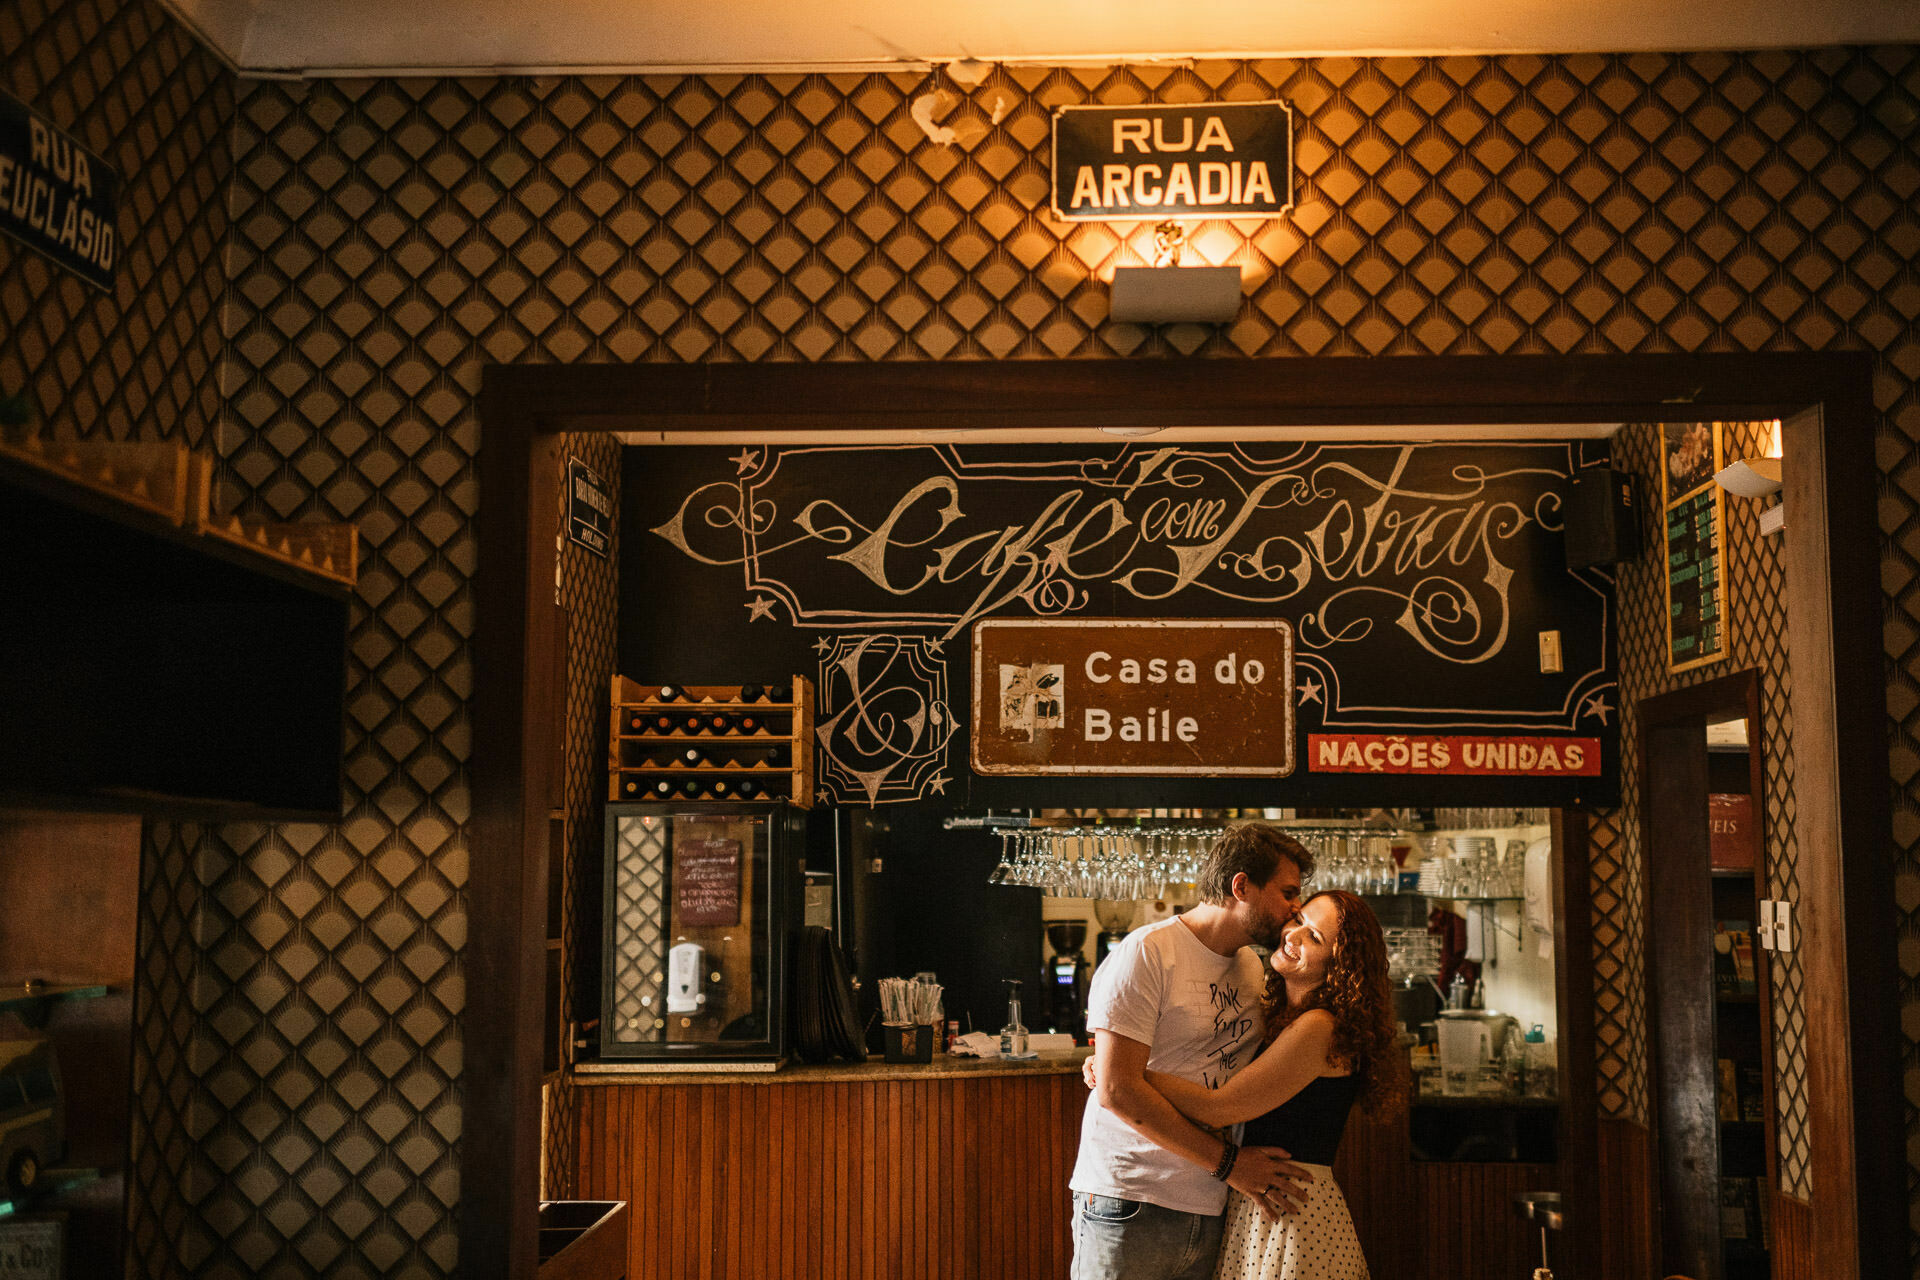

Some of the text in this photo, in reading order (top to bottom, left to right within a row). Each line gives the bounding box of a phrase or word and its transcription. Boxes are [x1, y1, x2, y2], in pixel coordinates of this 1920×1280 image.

[1112, 116, 1235, 154] RUA
[28, 115, 92, 199] RUA
[1070, 161, 1277, 209] ARCADIA
[1140, 498, 1226, 543] com
[1113, 447, 1535, 664] Letras
[1084, 651, 1265, 684] Casa do
[1084, 707, 1199, 742] Baile
[1319, 736, 1584, 772] NAÇÕES UNIDAS
[1708, 819, 1737, 834] EIS
[1209, 983, 1243, 1014] PINK
[1207, 1039, 1239, 1071] THE
